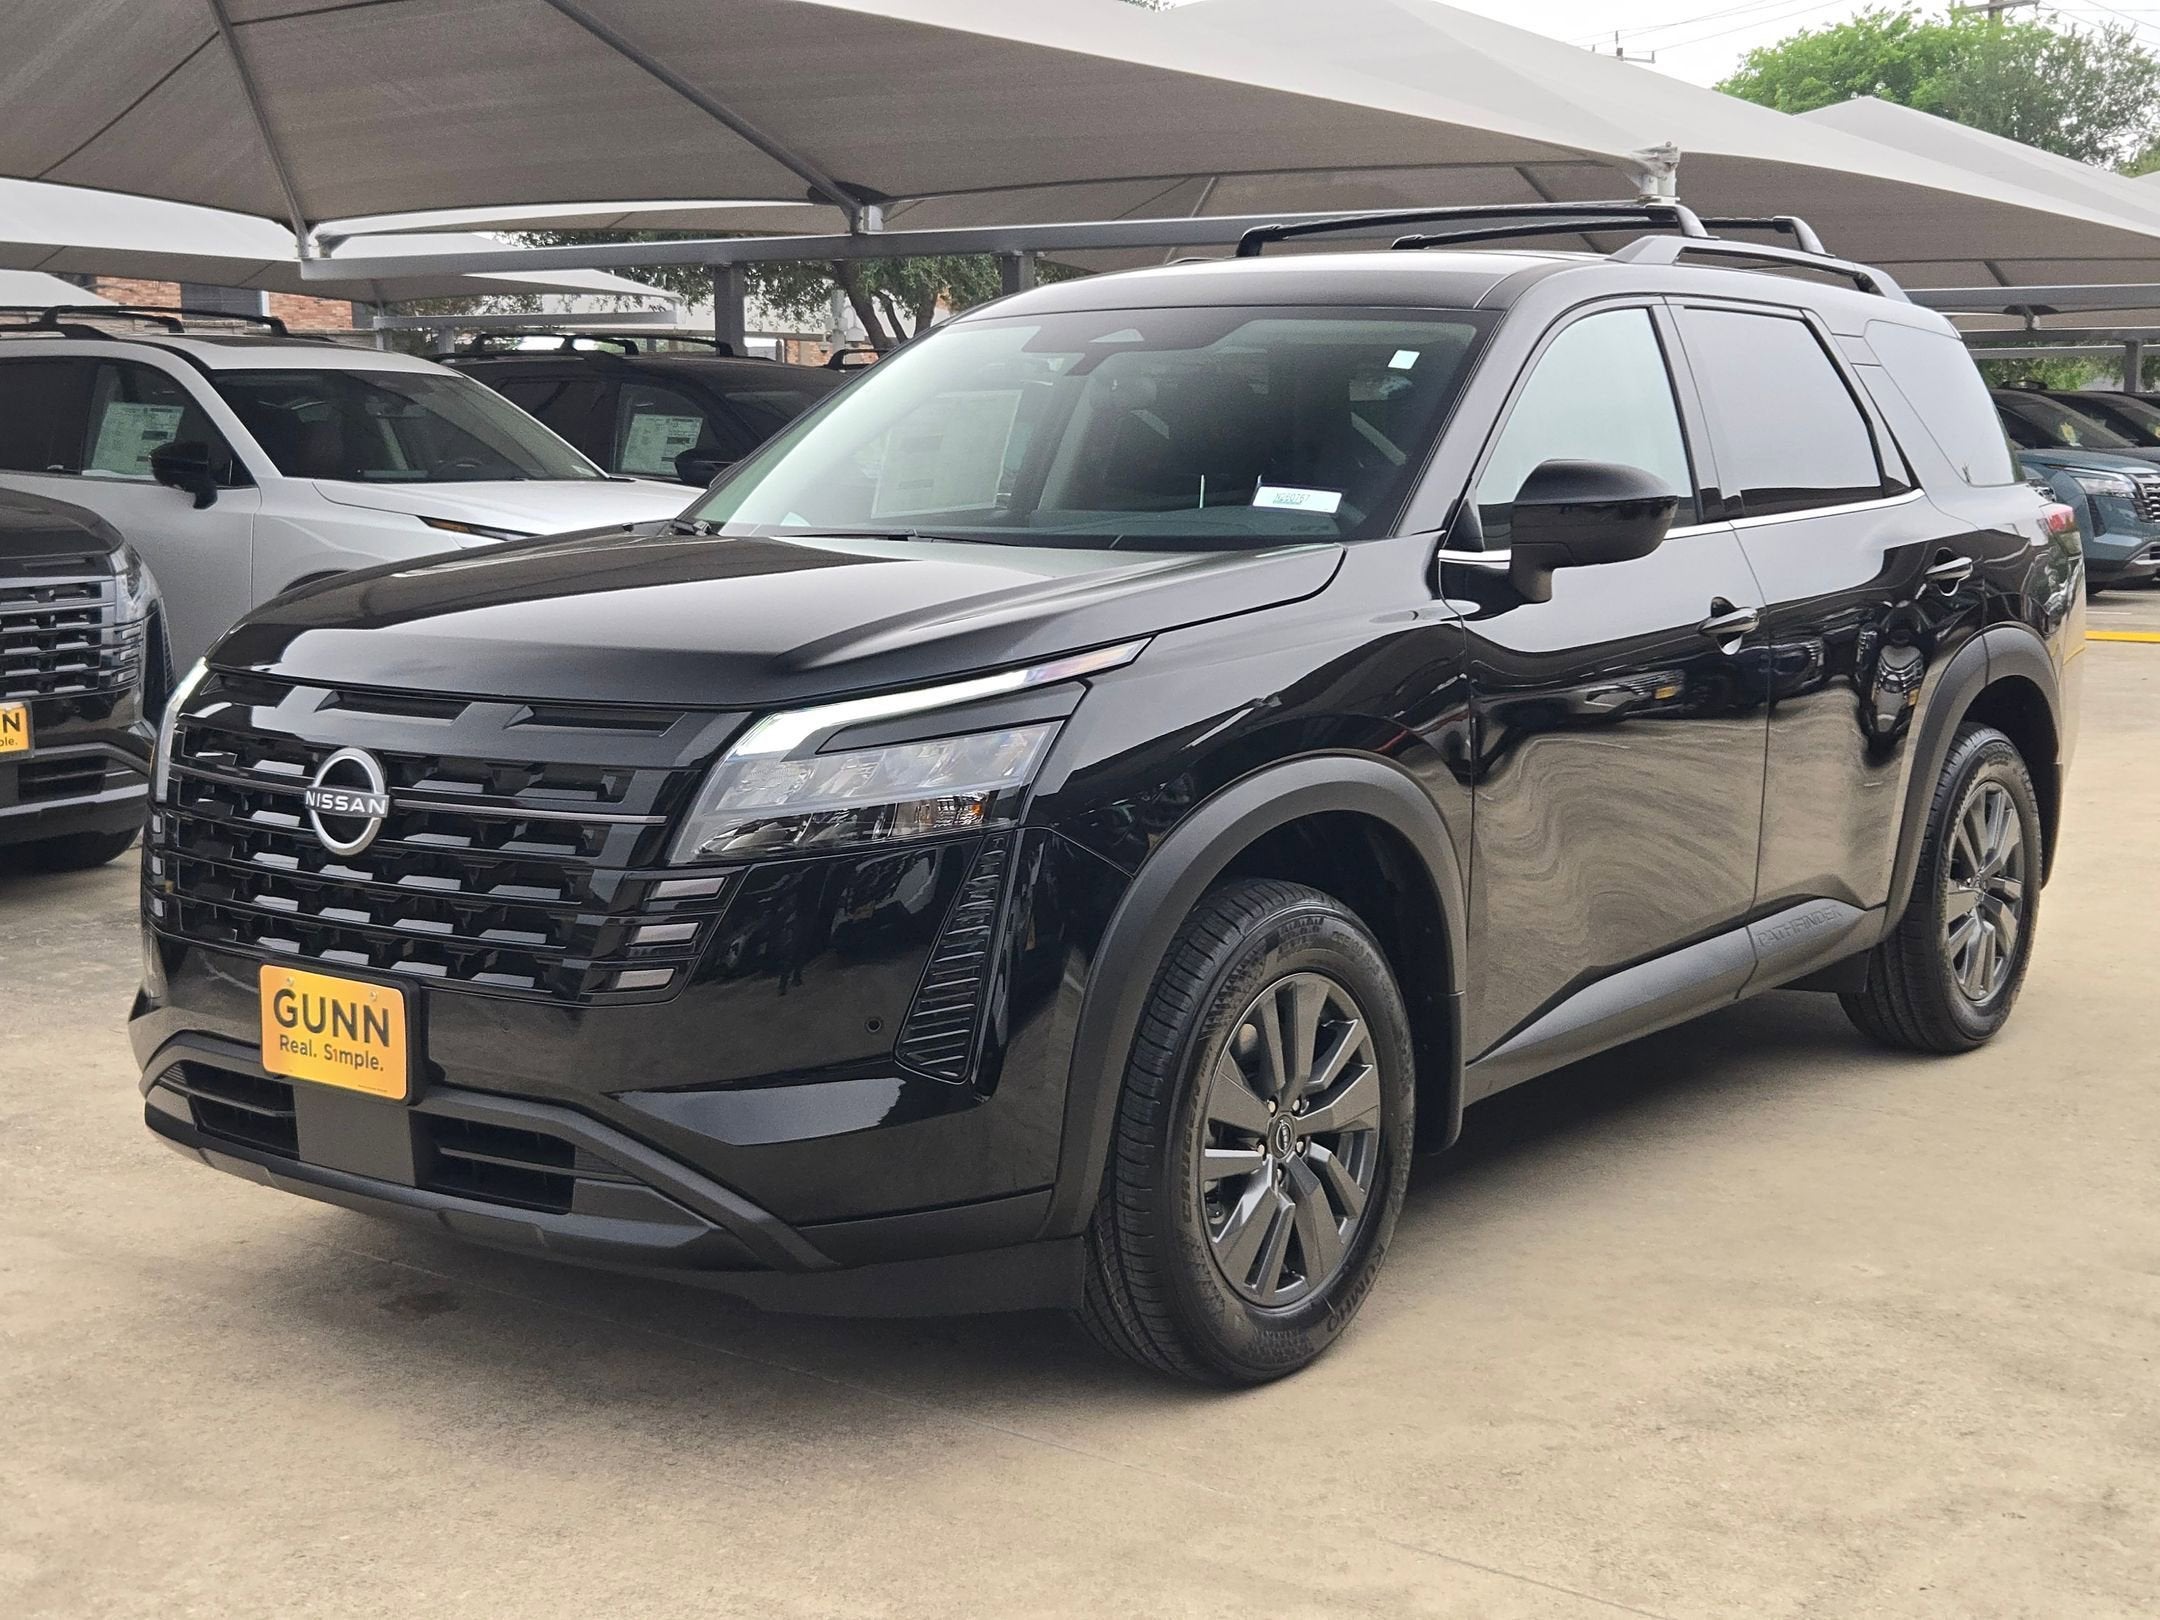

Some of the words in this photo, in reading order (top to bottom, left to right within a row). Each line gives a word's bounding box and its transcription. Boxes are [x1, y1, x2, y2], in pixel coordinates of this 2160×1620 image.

[305, 790, 386, 815] NISSAN
[273, 988, 391, 1048] GUNN
[279, 1034, 318, 1058] Real.
[1327, 1243, 1385, 1332] KUMHO
